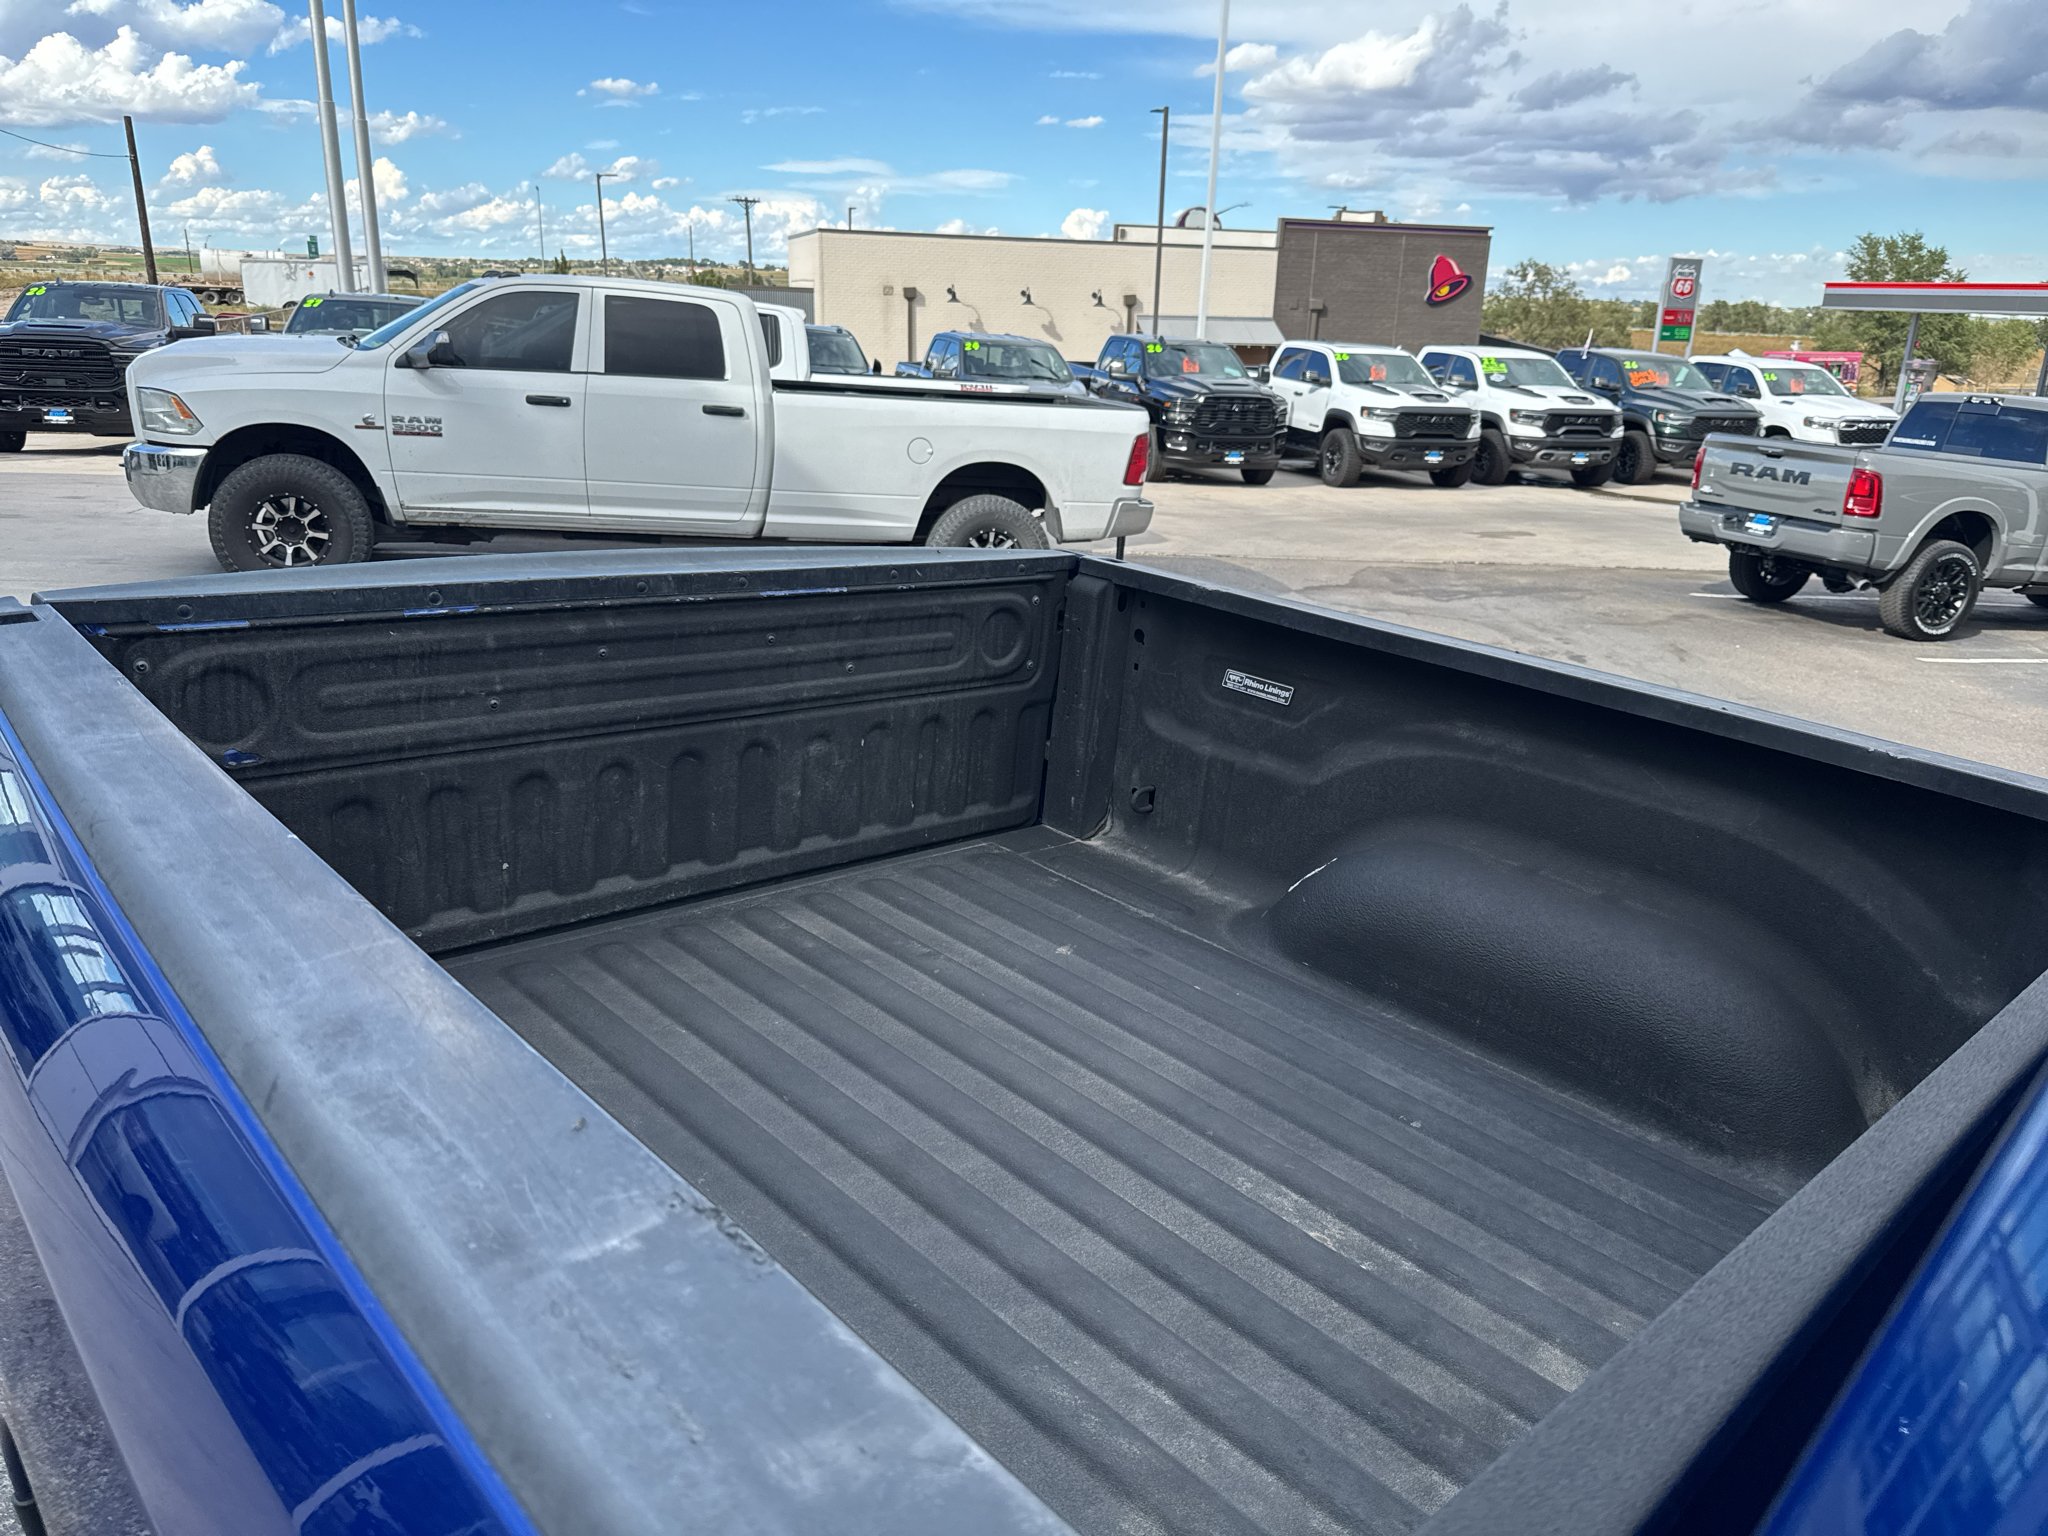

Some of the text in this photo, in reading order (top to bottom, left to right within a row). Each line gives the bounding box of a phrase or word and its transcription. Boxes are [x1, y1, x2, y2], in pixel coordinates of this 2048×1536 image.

[26, 286, 47, 296] 26
[1675, 280, 1693, 294] 66
[20, 347, 84, 359] RAM
[1623, 360, 1639, 370] 26
[391, 415, 442, 425] RAM
[392, 423, 443, 432] 3500
[1729, 462, 1812, 485] RAM
[1244, 678, 1264, 690] Rhino
[1264, 683, 1291, 698] Linings
